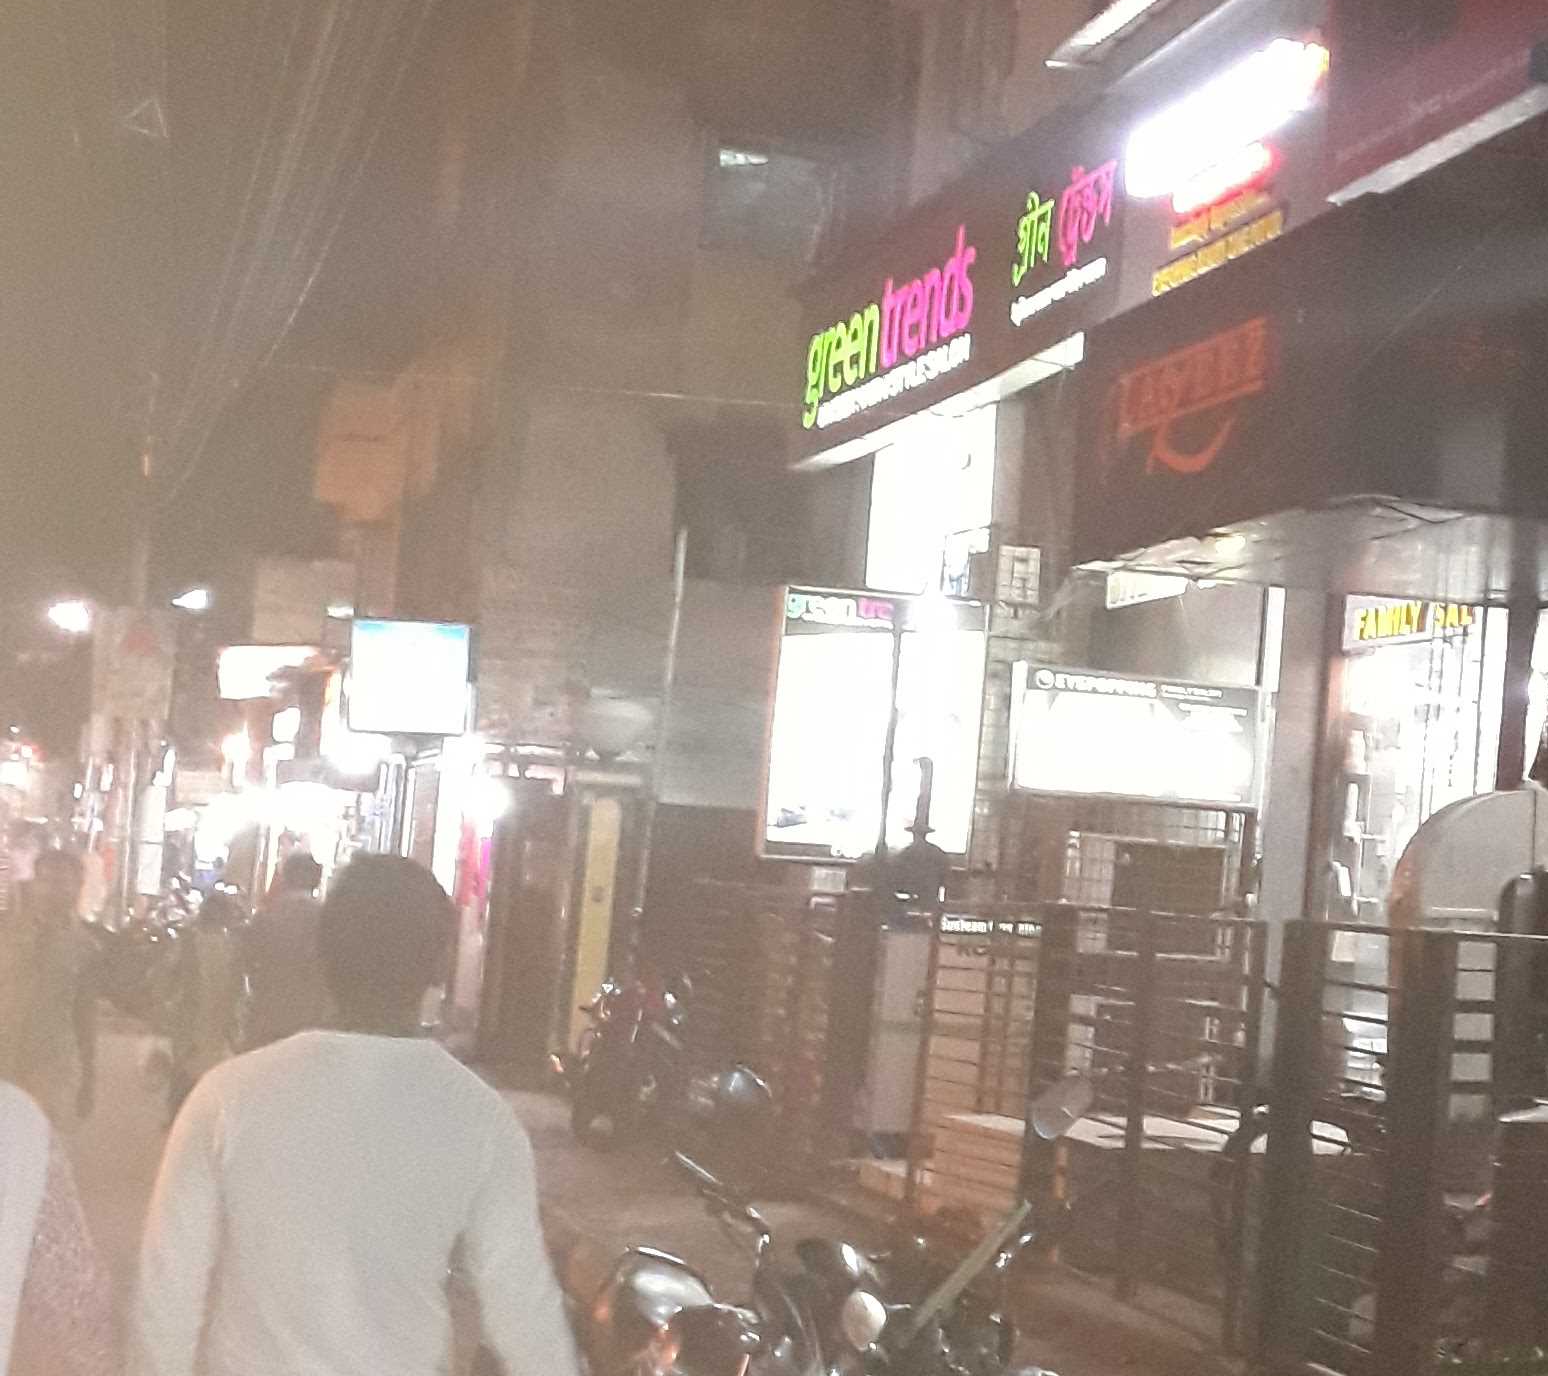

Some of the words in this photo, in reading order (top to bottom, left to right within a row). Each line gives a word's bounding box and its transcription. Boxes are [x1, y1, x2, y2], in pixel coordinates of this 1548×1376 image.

[803, 303, 881, 429] green
[881, 224, 976, 369] trends
[1353, 600, 1422, 641] FAMILY
